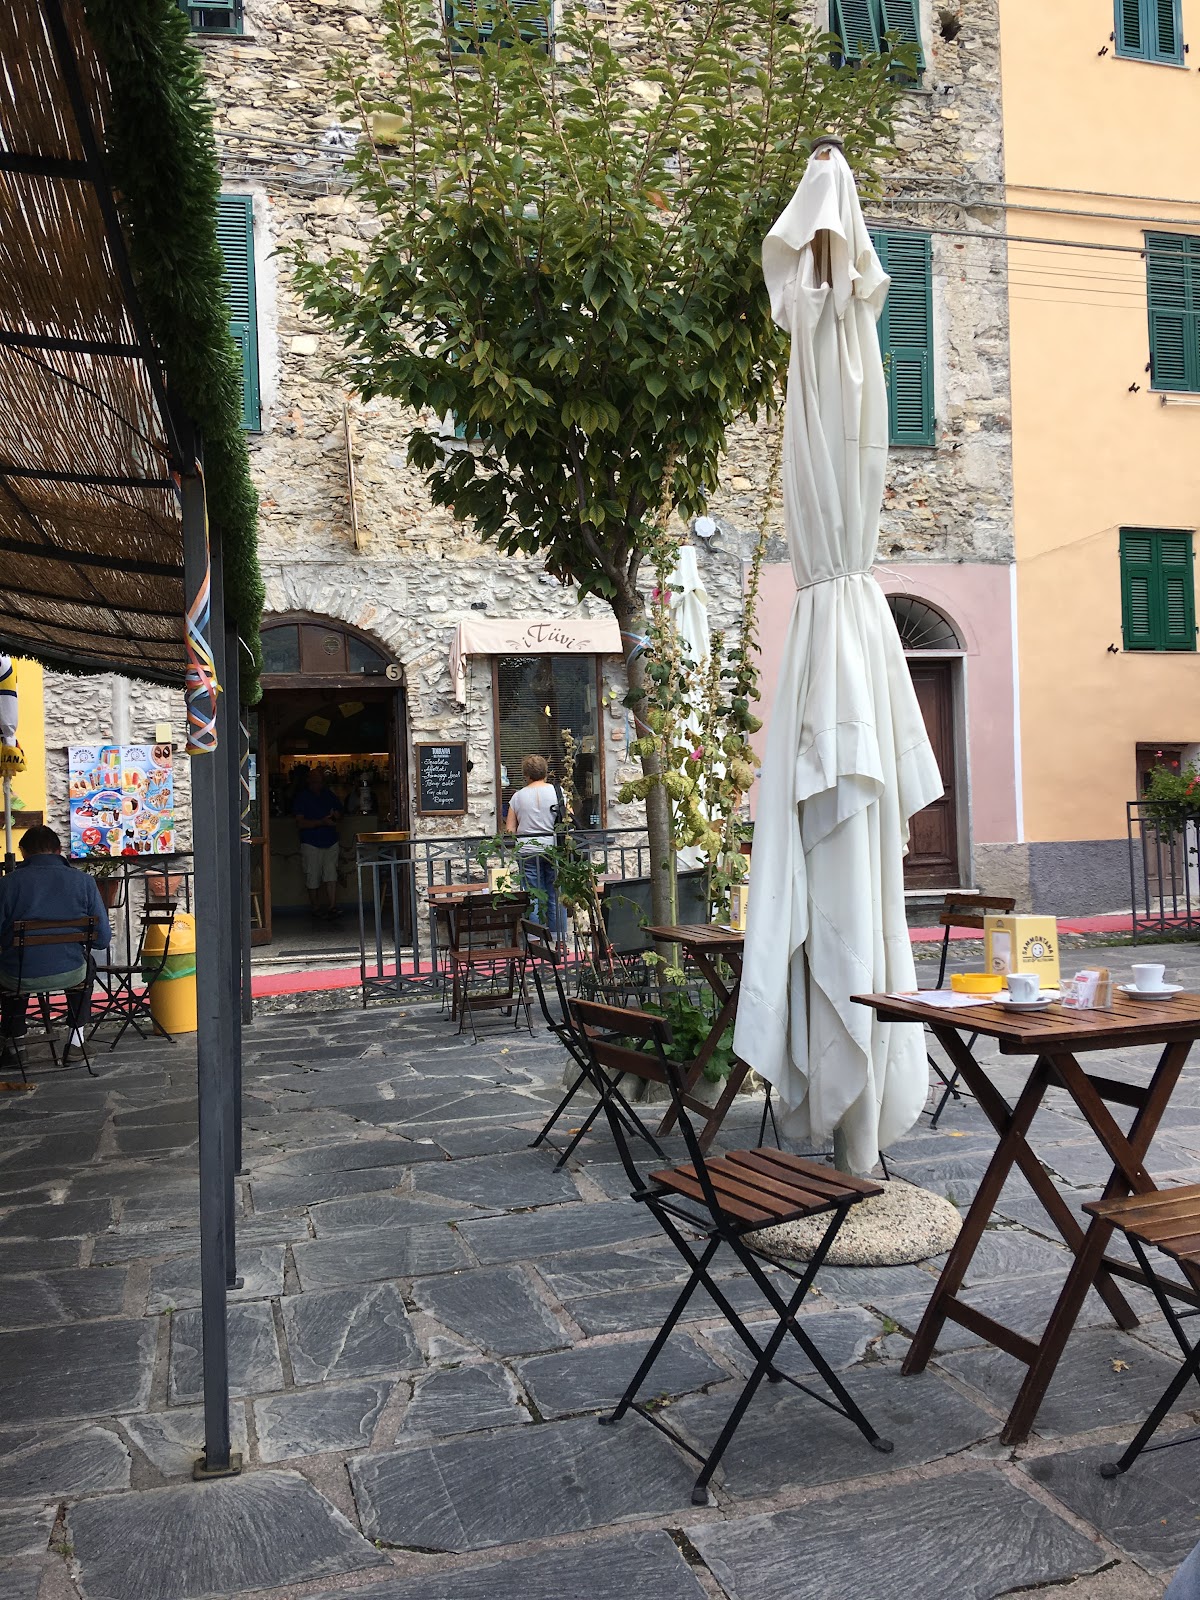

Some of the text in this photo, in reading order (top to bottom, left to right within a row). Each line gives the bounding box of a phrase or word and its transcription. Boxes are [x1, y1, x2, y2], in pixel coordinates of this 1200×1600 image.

[521, 622, 576, 649] i Tüvi
[390, 666, 398, 679] 5
[1021, 935, 1054, 956] SAMMONTANA
